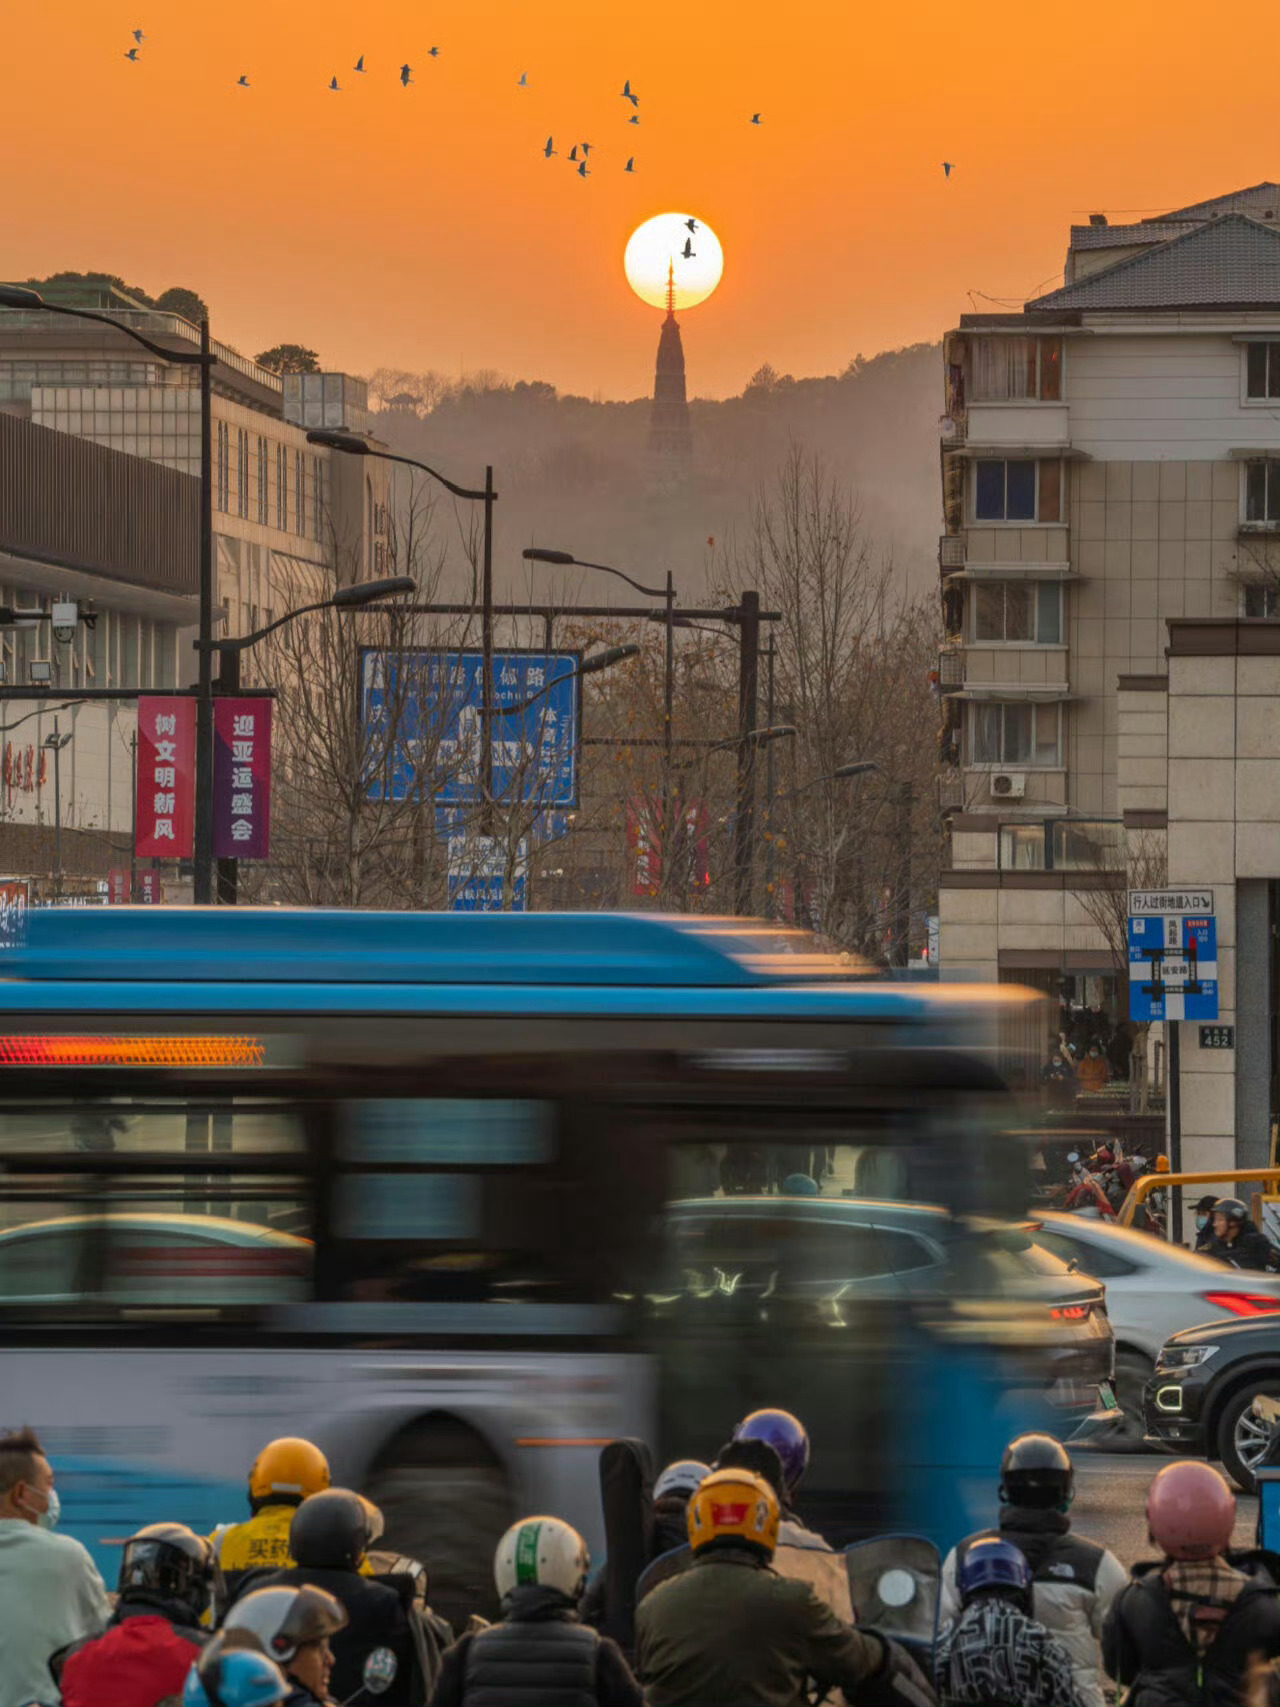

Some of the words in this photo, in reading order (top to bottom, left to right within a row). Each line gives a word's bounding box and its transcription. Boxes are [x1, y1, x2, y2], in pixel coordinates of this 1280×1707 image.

[154, 713, 176, 841] 树文明新风
[231, 715, 255, 841] 迎亚运盛会
[1133, 895, 1200, 909] 行人过街地道入口
[1204, 1035, 1229, 1047] 452
